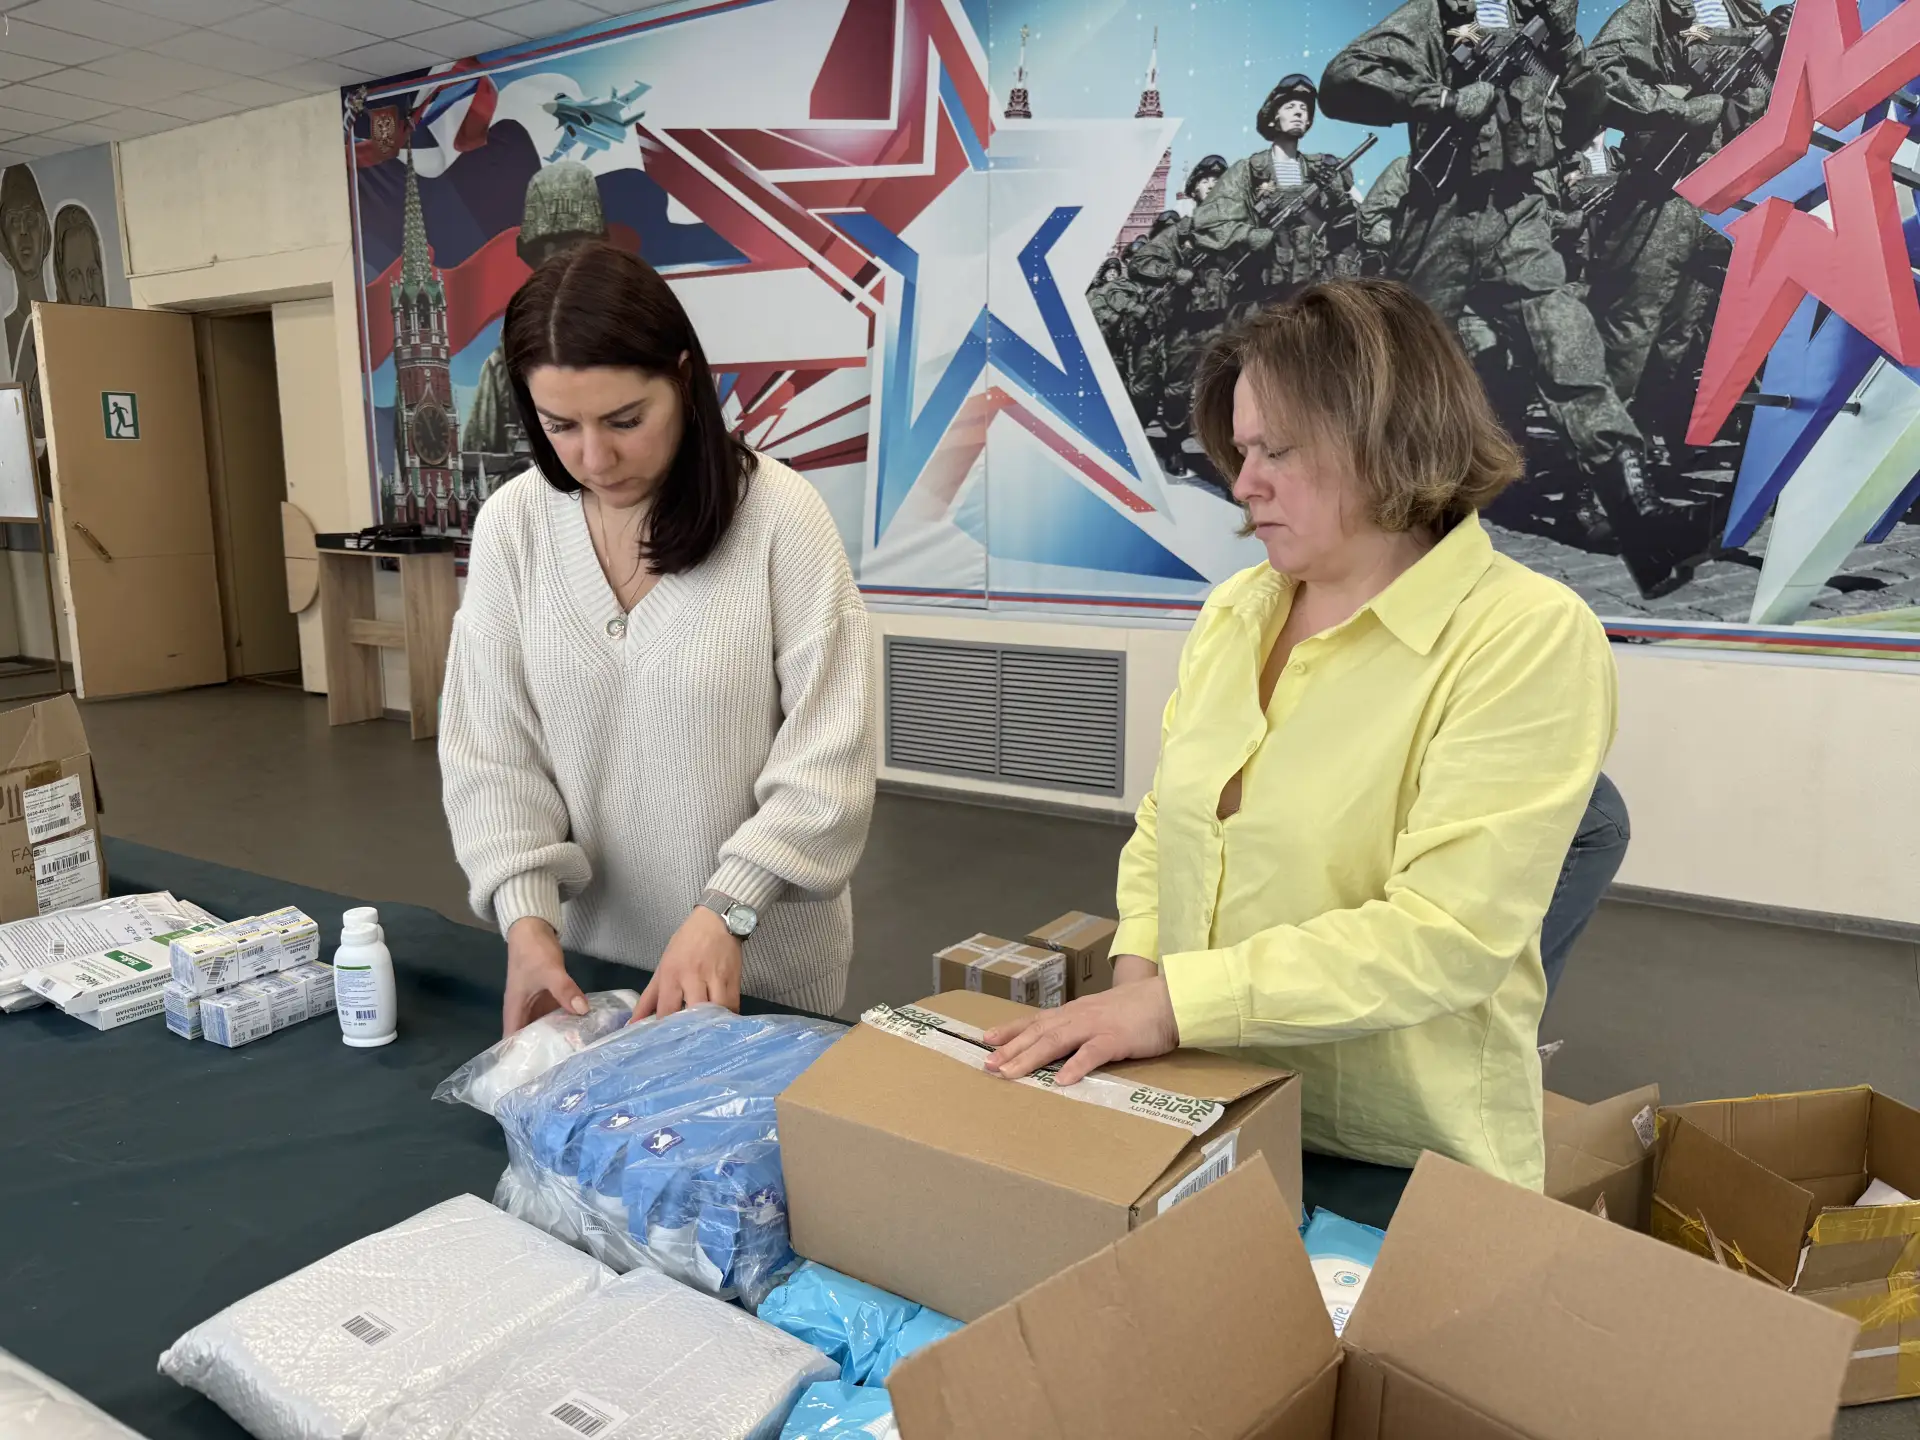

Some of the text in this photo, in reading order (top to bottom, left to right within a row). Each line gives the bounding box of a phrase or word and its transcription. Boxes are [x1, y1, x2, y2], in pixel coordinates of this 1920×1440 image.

[98, 982, 141, 999] СТЕРИЛЬНАЯ
[98, 984, 152, 1005] МЕДИЦИНСКАЯ
[115, 999, 158, 1017] СТЕРИЛЬНАЯ
[1129, 1090, 1208, 1122] Зелёна
[1130, 1105, 1195, 1127] PREMIUM QUALITY
